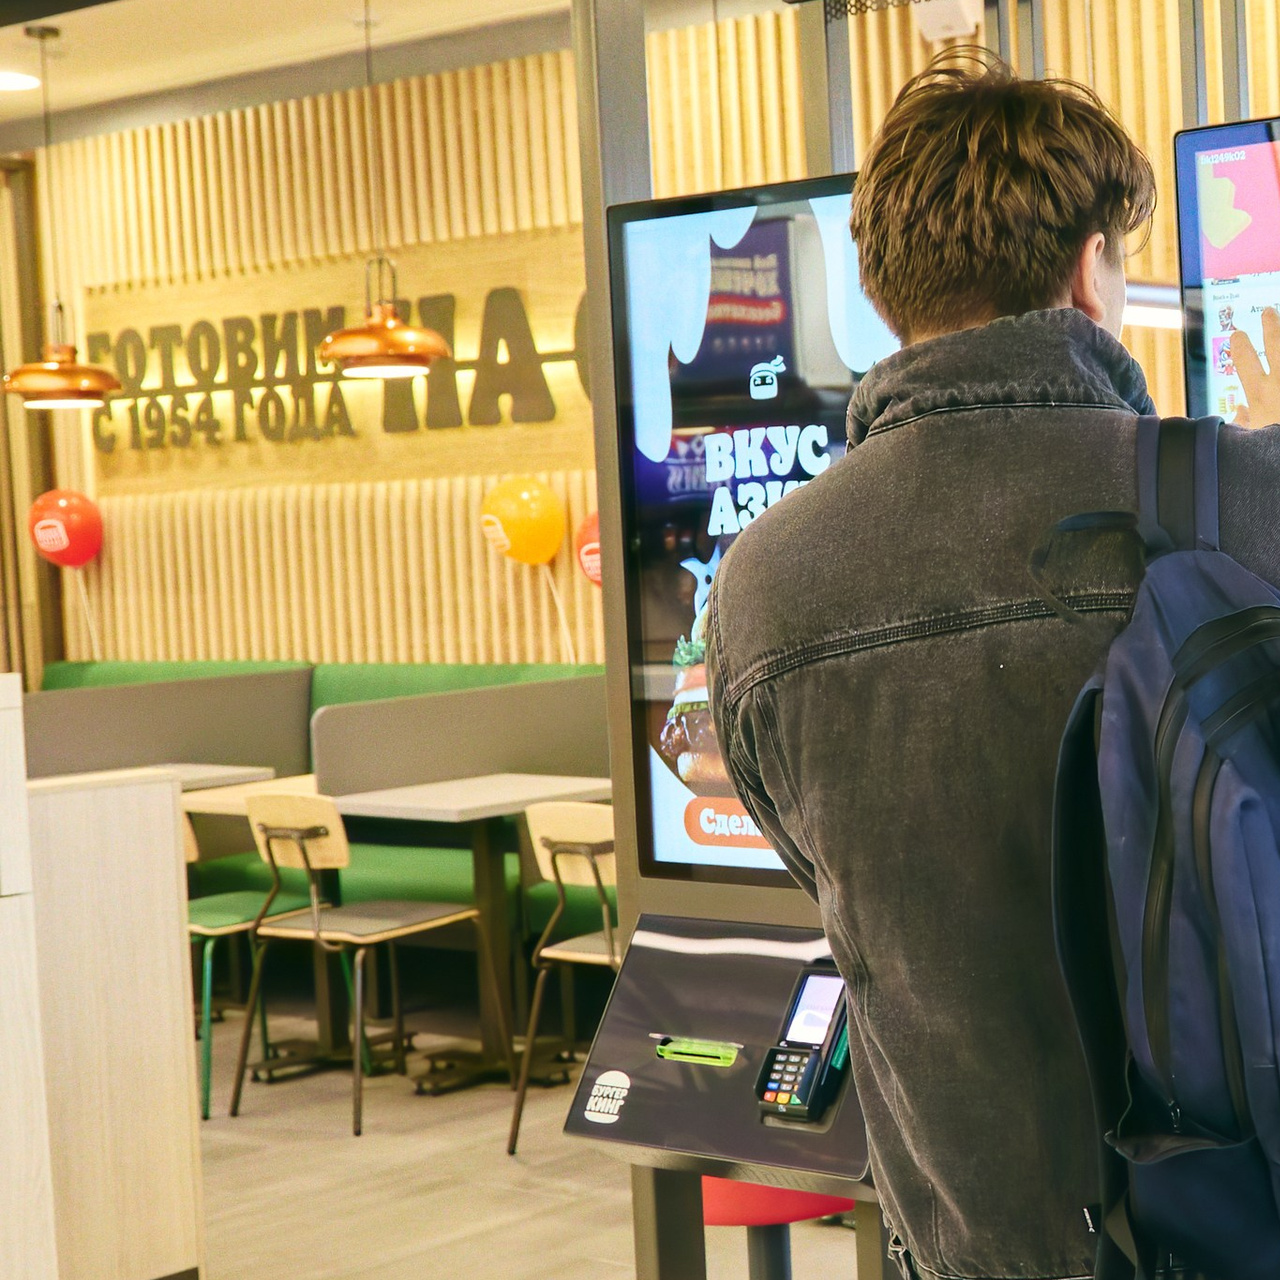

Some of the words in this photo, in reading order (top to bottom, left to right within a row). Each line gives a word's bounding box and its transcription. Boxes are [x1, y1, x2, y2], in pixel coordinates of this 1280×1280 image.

[129, 392, 221, 451] 1954
[232, 381, 357, 442] ГОДА
[704, 425, 831, 482] ВКУС
[699, 808, 763, 837] Сдел
[586, 1096, 625, 1114] КИНГ
[591, 1084, 628, 1099] БУРГЕР
